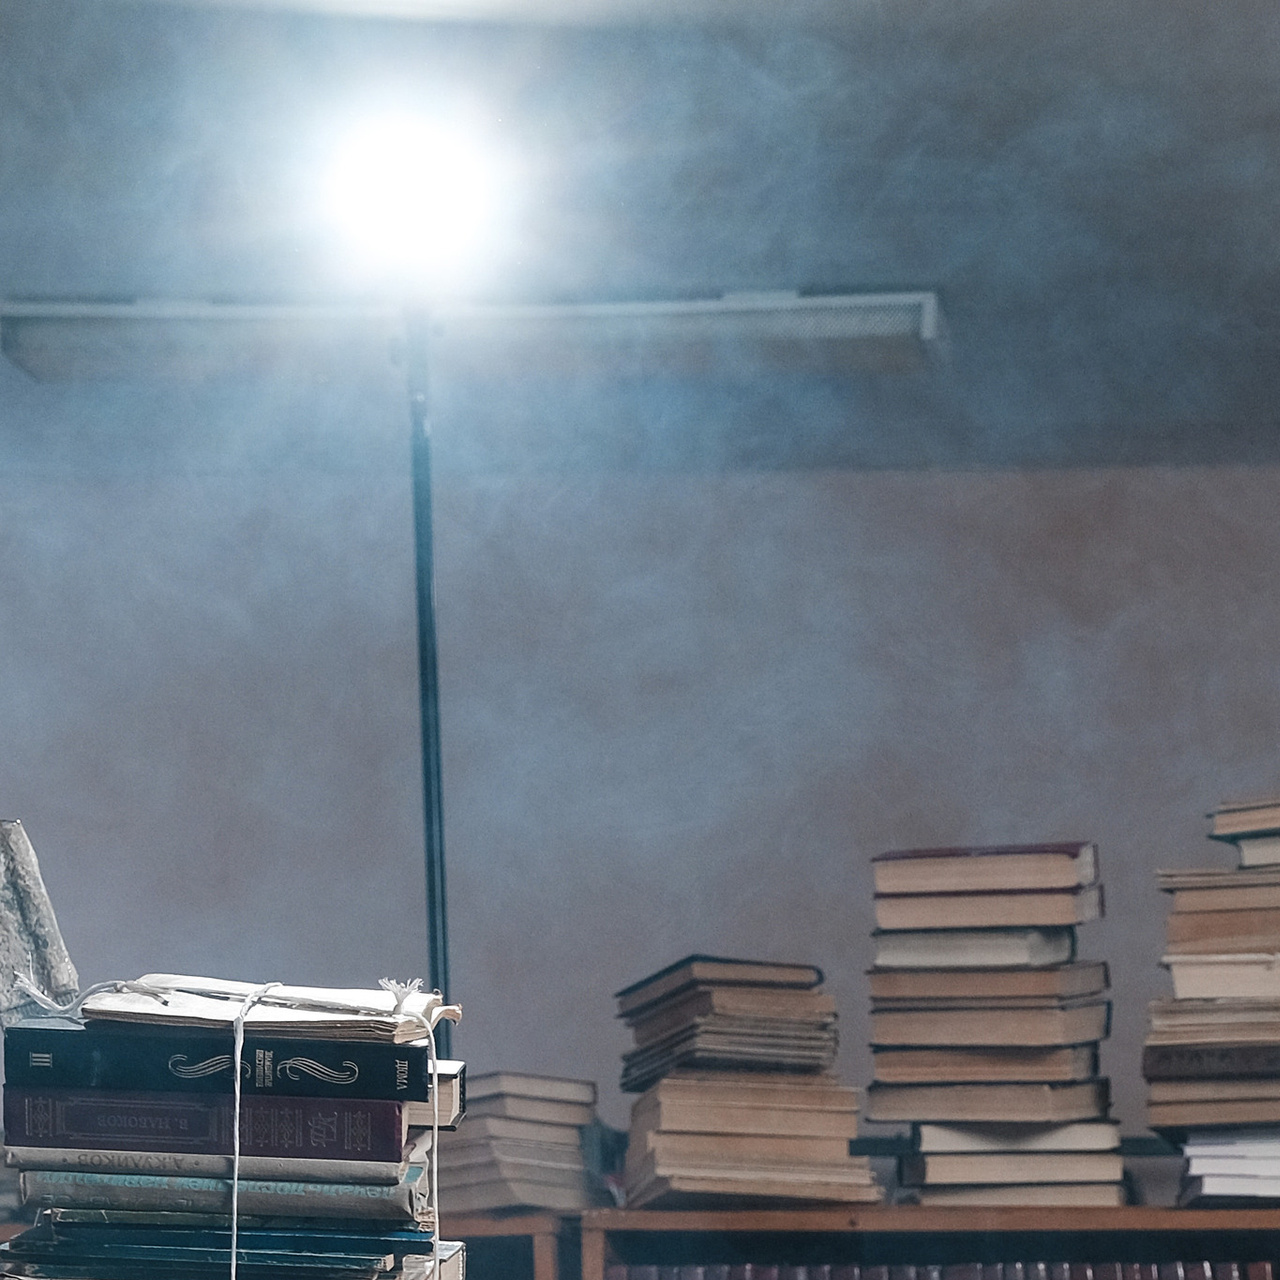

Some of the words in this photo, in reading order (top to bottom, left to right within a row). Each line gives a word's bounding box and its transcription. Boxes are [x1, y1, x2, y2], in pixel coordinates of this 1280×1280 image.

[396, 1059, 409, 1091] ДЮМА
[97, 1114, 173, 1130] НАБОКОВ
[77, 1153, 186, 1170] А.КУЛИКОВ
